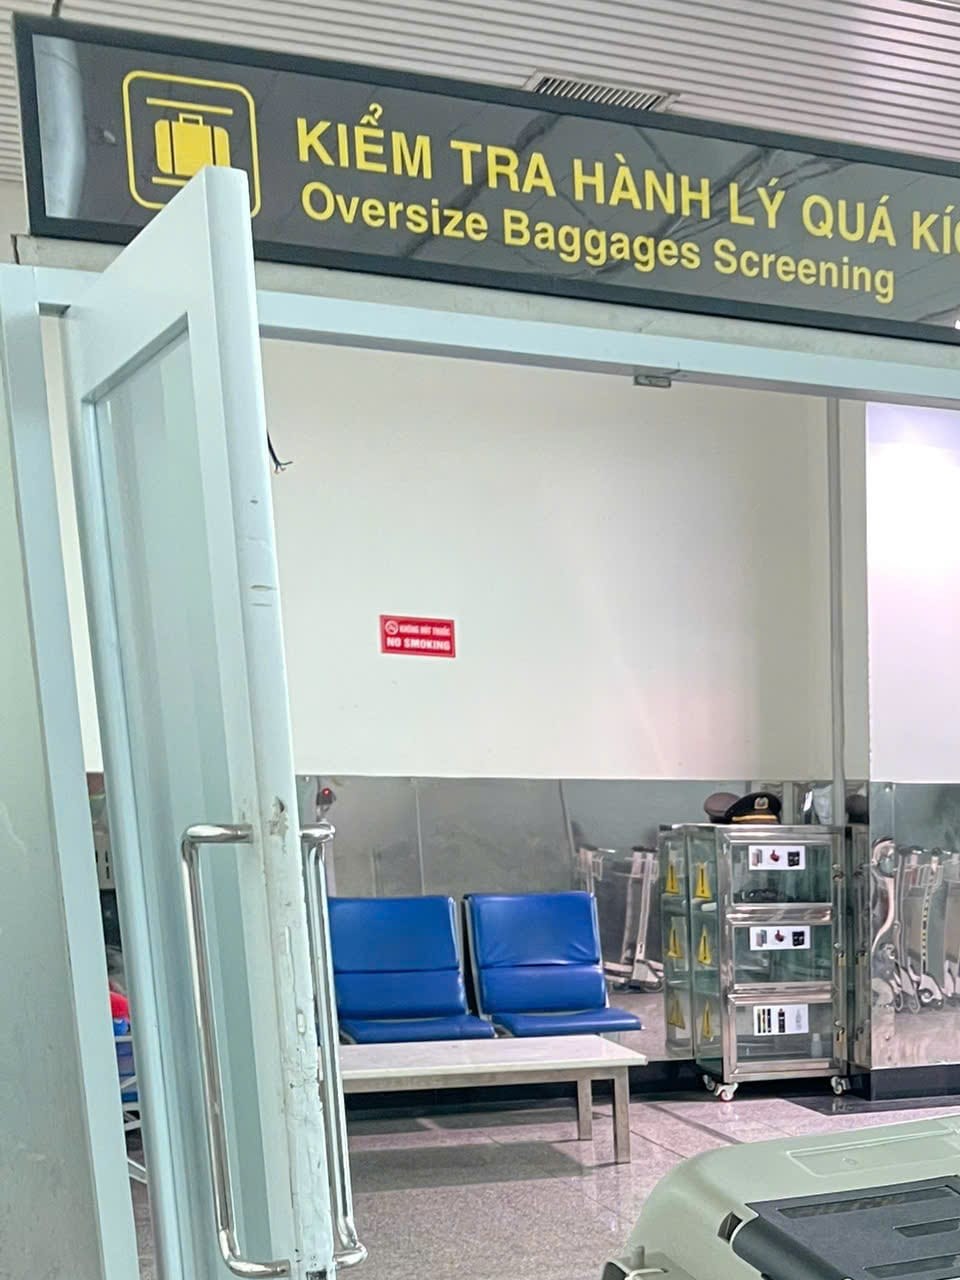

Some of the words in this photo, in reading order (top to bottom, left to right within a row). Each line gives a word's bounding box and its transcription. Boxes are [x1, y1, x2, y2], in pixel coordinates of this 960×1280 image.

[296, 103, 432, 180] KIỂM
[451, 139, 556, 197] TRA
[573, 153, 711, 220] HÀNH
[729, 183, 786, 230] LÝ
[802, 194, 897, 247] QUÁ
[301, 181, 488, 241] Oversize
[503, 207, 701, 273] Baggages
[713, 238, 895, 304] Screening
[386, 637, 402, 648] NO
[404, 638, 451, 651] SMOKING
